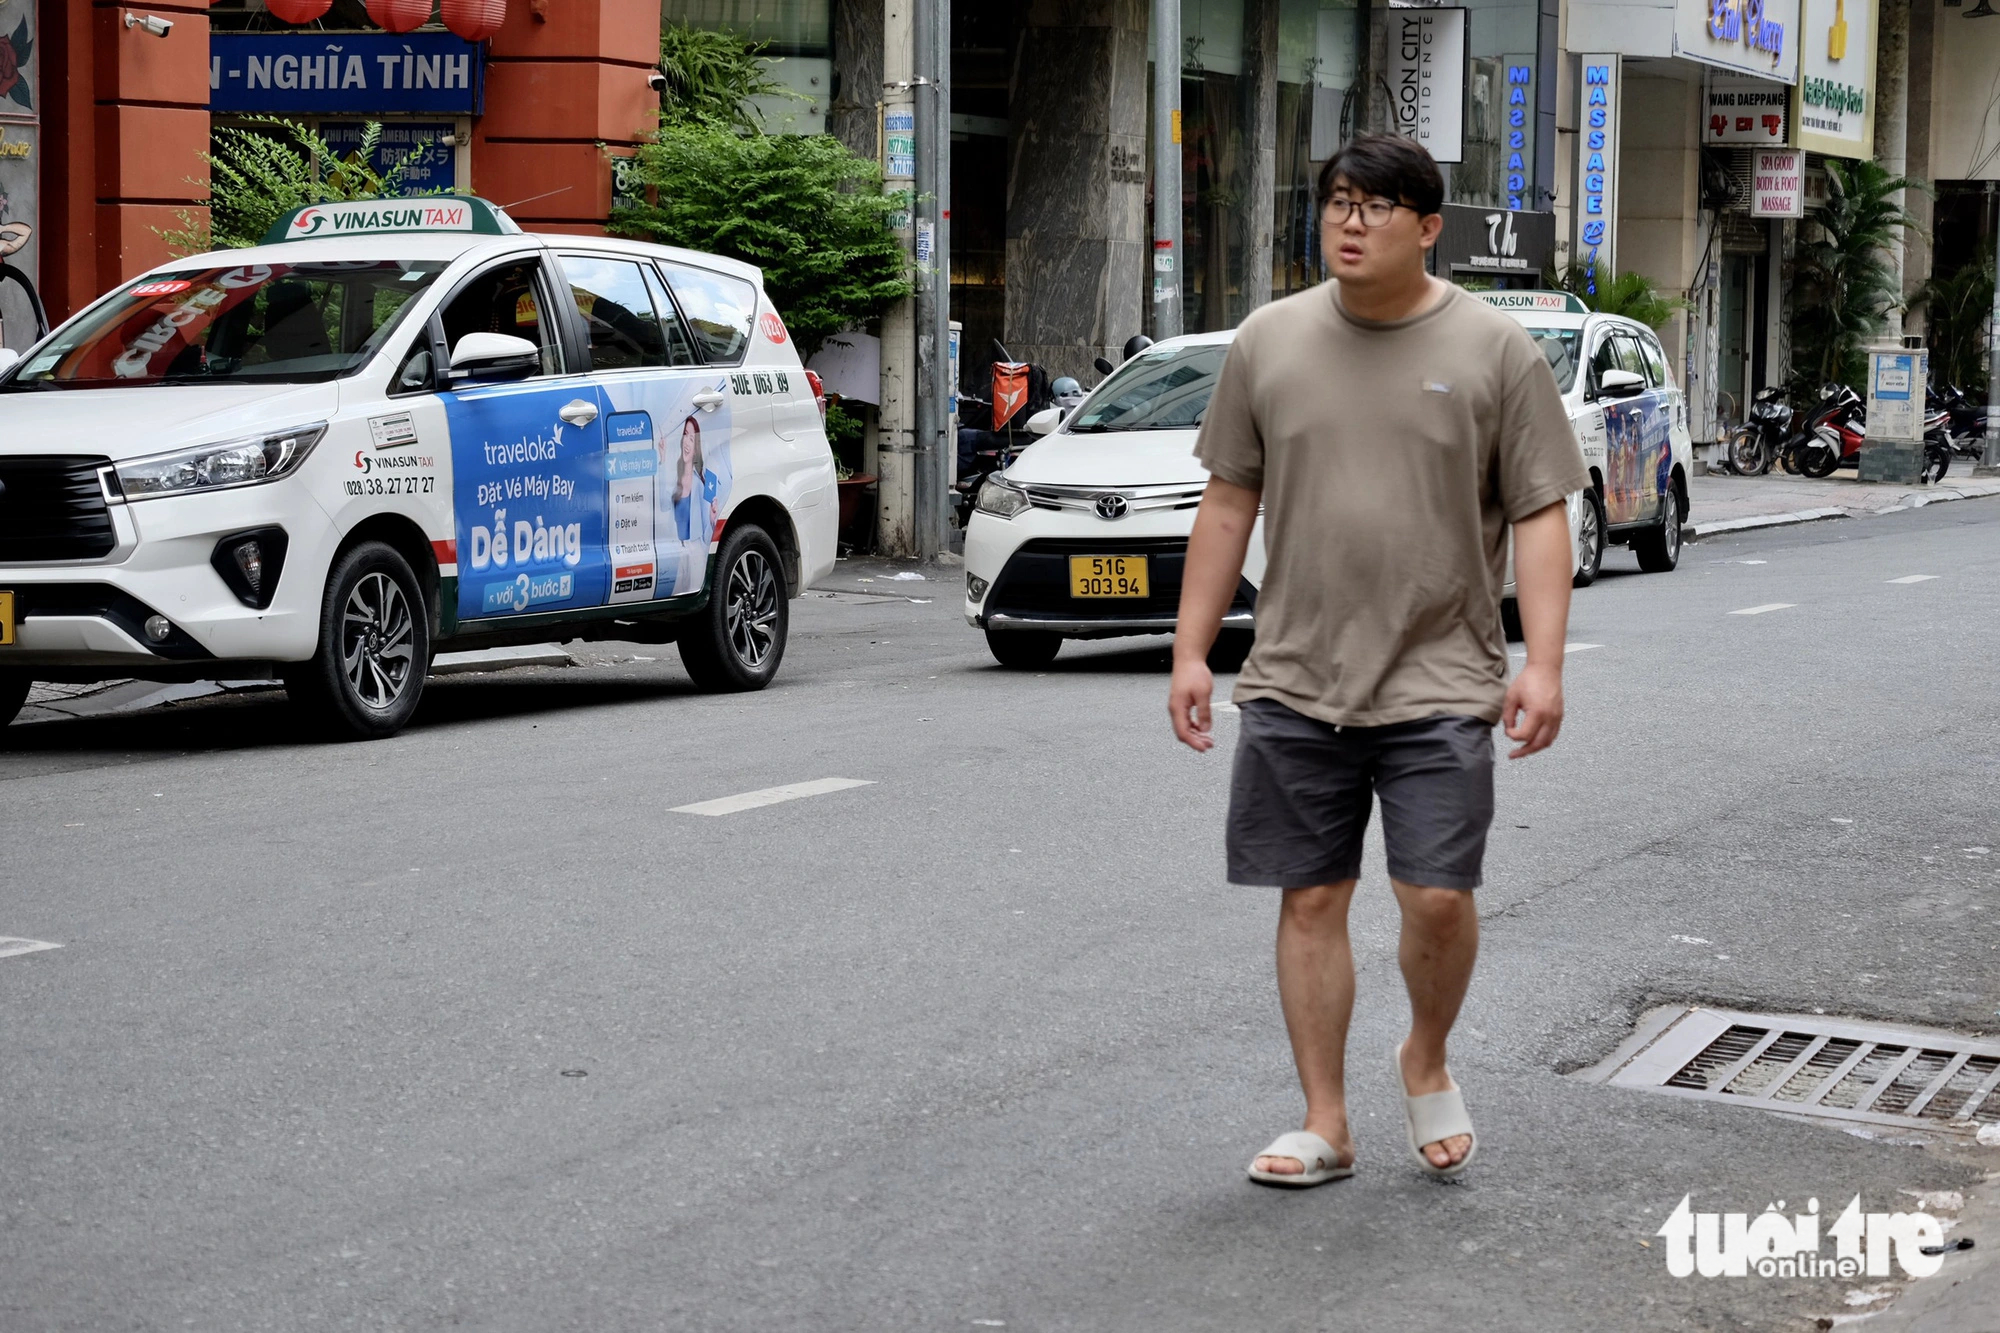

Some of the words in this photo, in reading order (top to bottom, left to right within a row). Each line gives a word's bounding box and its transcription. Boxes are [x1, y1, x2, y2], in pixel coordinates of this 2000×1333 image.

[1402, 17, 1419, 61] CITY
[247, 44, 367, 89] NGHĨA
[377, 45, 469, 89] TÌNH
[1421, 16, 1433, 139] ESIDENCE
[1710, 94, 1735, 106] WANG
[1738, 94, 1784, 106] DAEPPANG
[1586, 66, 1609, 214] MASSAGE
[1761, 155, 1773, 171] SPA
[1774, 156, 1794, 171] GOOD
[1756, 176, 1773, 191] BODY
[1774, 178, 1780, 191] &
[1781, 176, 1798, 191] FOOT
[1761, 196, 1791, 211] MASSAGE
[333, 210, 423, 229] VINASUN
[425, 208, 463, 225] TAXI
[1536, 297, 1561, 307] TAXI
[484, 435, 556, 465] traveloka
[374, 456, 418, 468] VINASUN
[418, 457, 434, 467] TAXI
[405, 477, 418, 493] 27
[421, 477, 434, 493] 27
[477, 481, 503, 509] Đặt
[505, 477, 522, 499] Vé
[524, 474, 550, 500] Máy
[552, 475, 575, 500] Bay
[471, 508, 509, 569] Dễ
[514, 515, 581, 566] Dàng
[1092, 558, 1125, 576] 51G
[496, 585, 513, 605] với
[513, 573, 530, 611] 3
[531, 578, 559, 599] bước
[1079, 577, 1139, 595] 303.94
